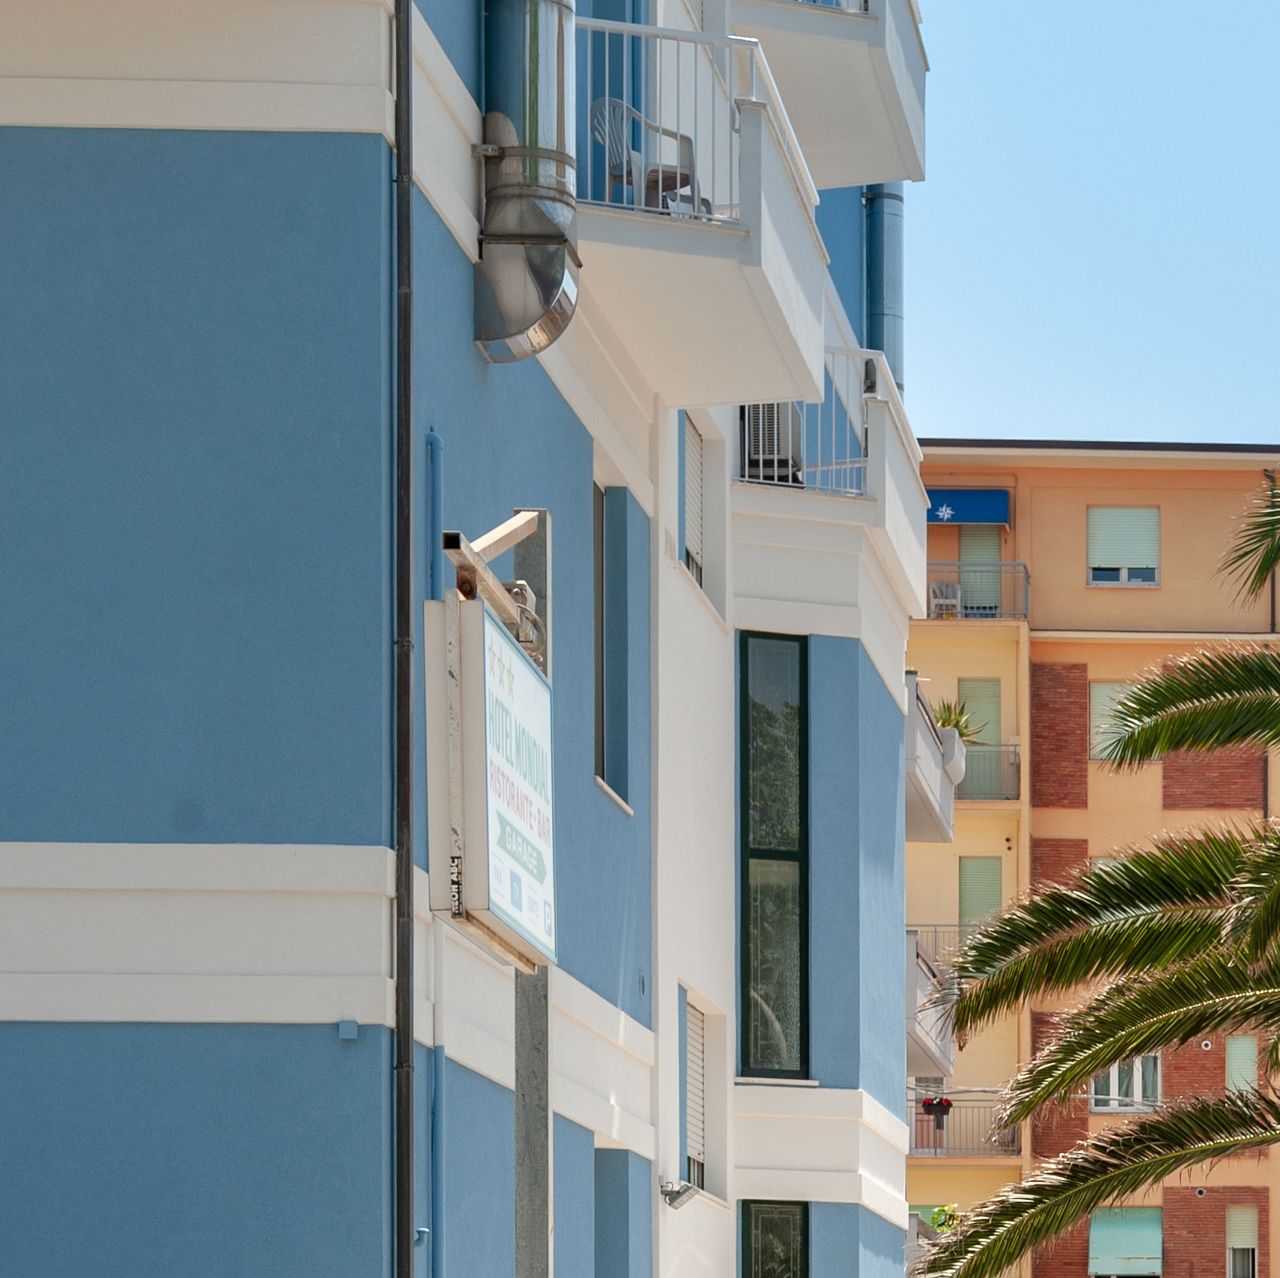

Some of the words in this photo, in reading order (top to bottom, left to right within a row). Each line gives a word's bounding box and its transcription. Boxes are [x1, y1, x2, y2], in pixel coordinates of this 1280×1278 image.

[488, 688, 514, 769] HOTEL
[515, 717, 551, 807] MONDIAL
[489, 758, 534, 831] RISTORANTE
[537, 807, 551, 849] BAR
[505, 824, 539, 877] GARAGE
